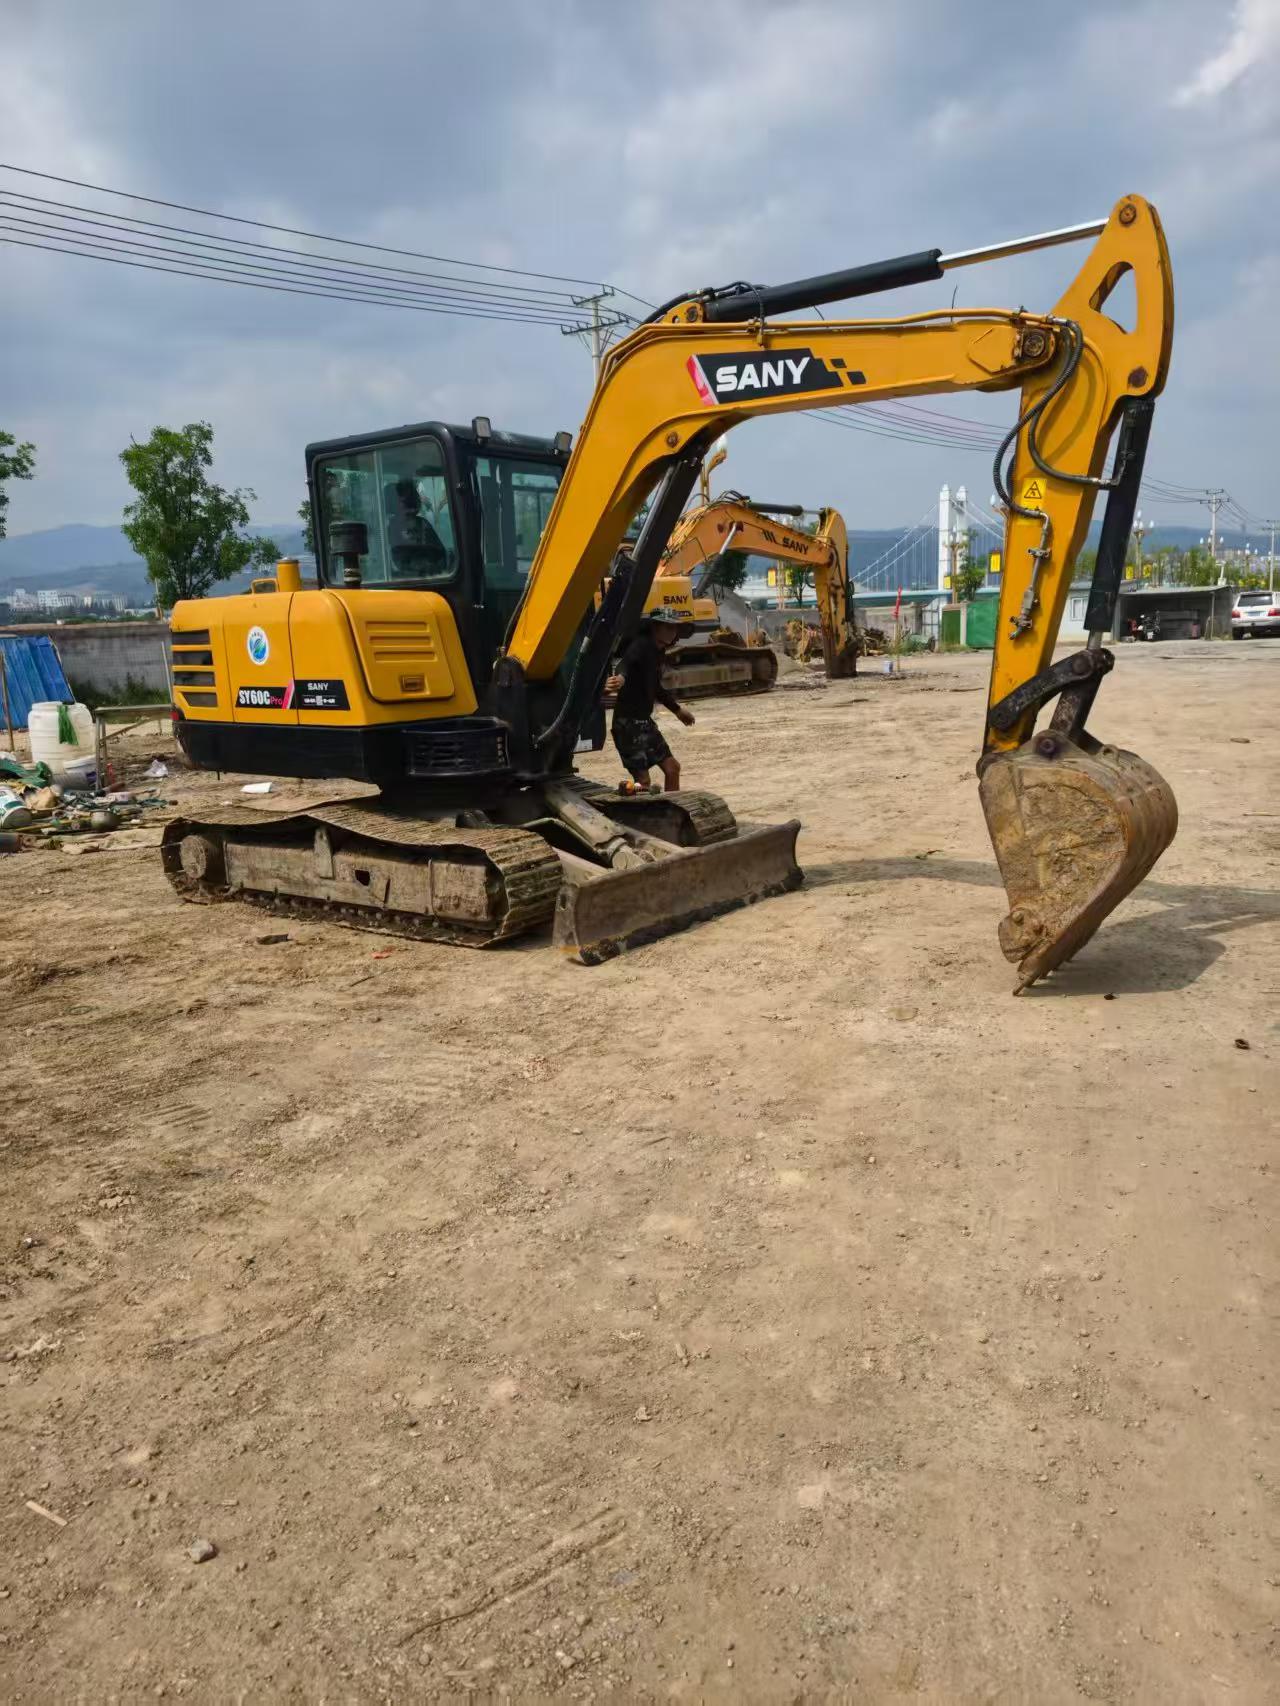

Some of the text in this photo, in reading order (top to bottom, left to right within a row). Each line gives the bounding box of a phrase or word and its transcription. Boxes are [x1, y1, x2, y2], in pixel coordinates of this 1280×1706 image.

[716, 357, 810, 392] SANY
[782, 538, 809, 555] SANY
[663, 595, 688, 605] SANY
[308, 683, 328, 691] SANY
[239, 690, 270, 705] SY60C
